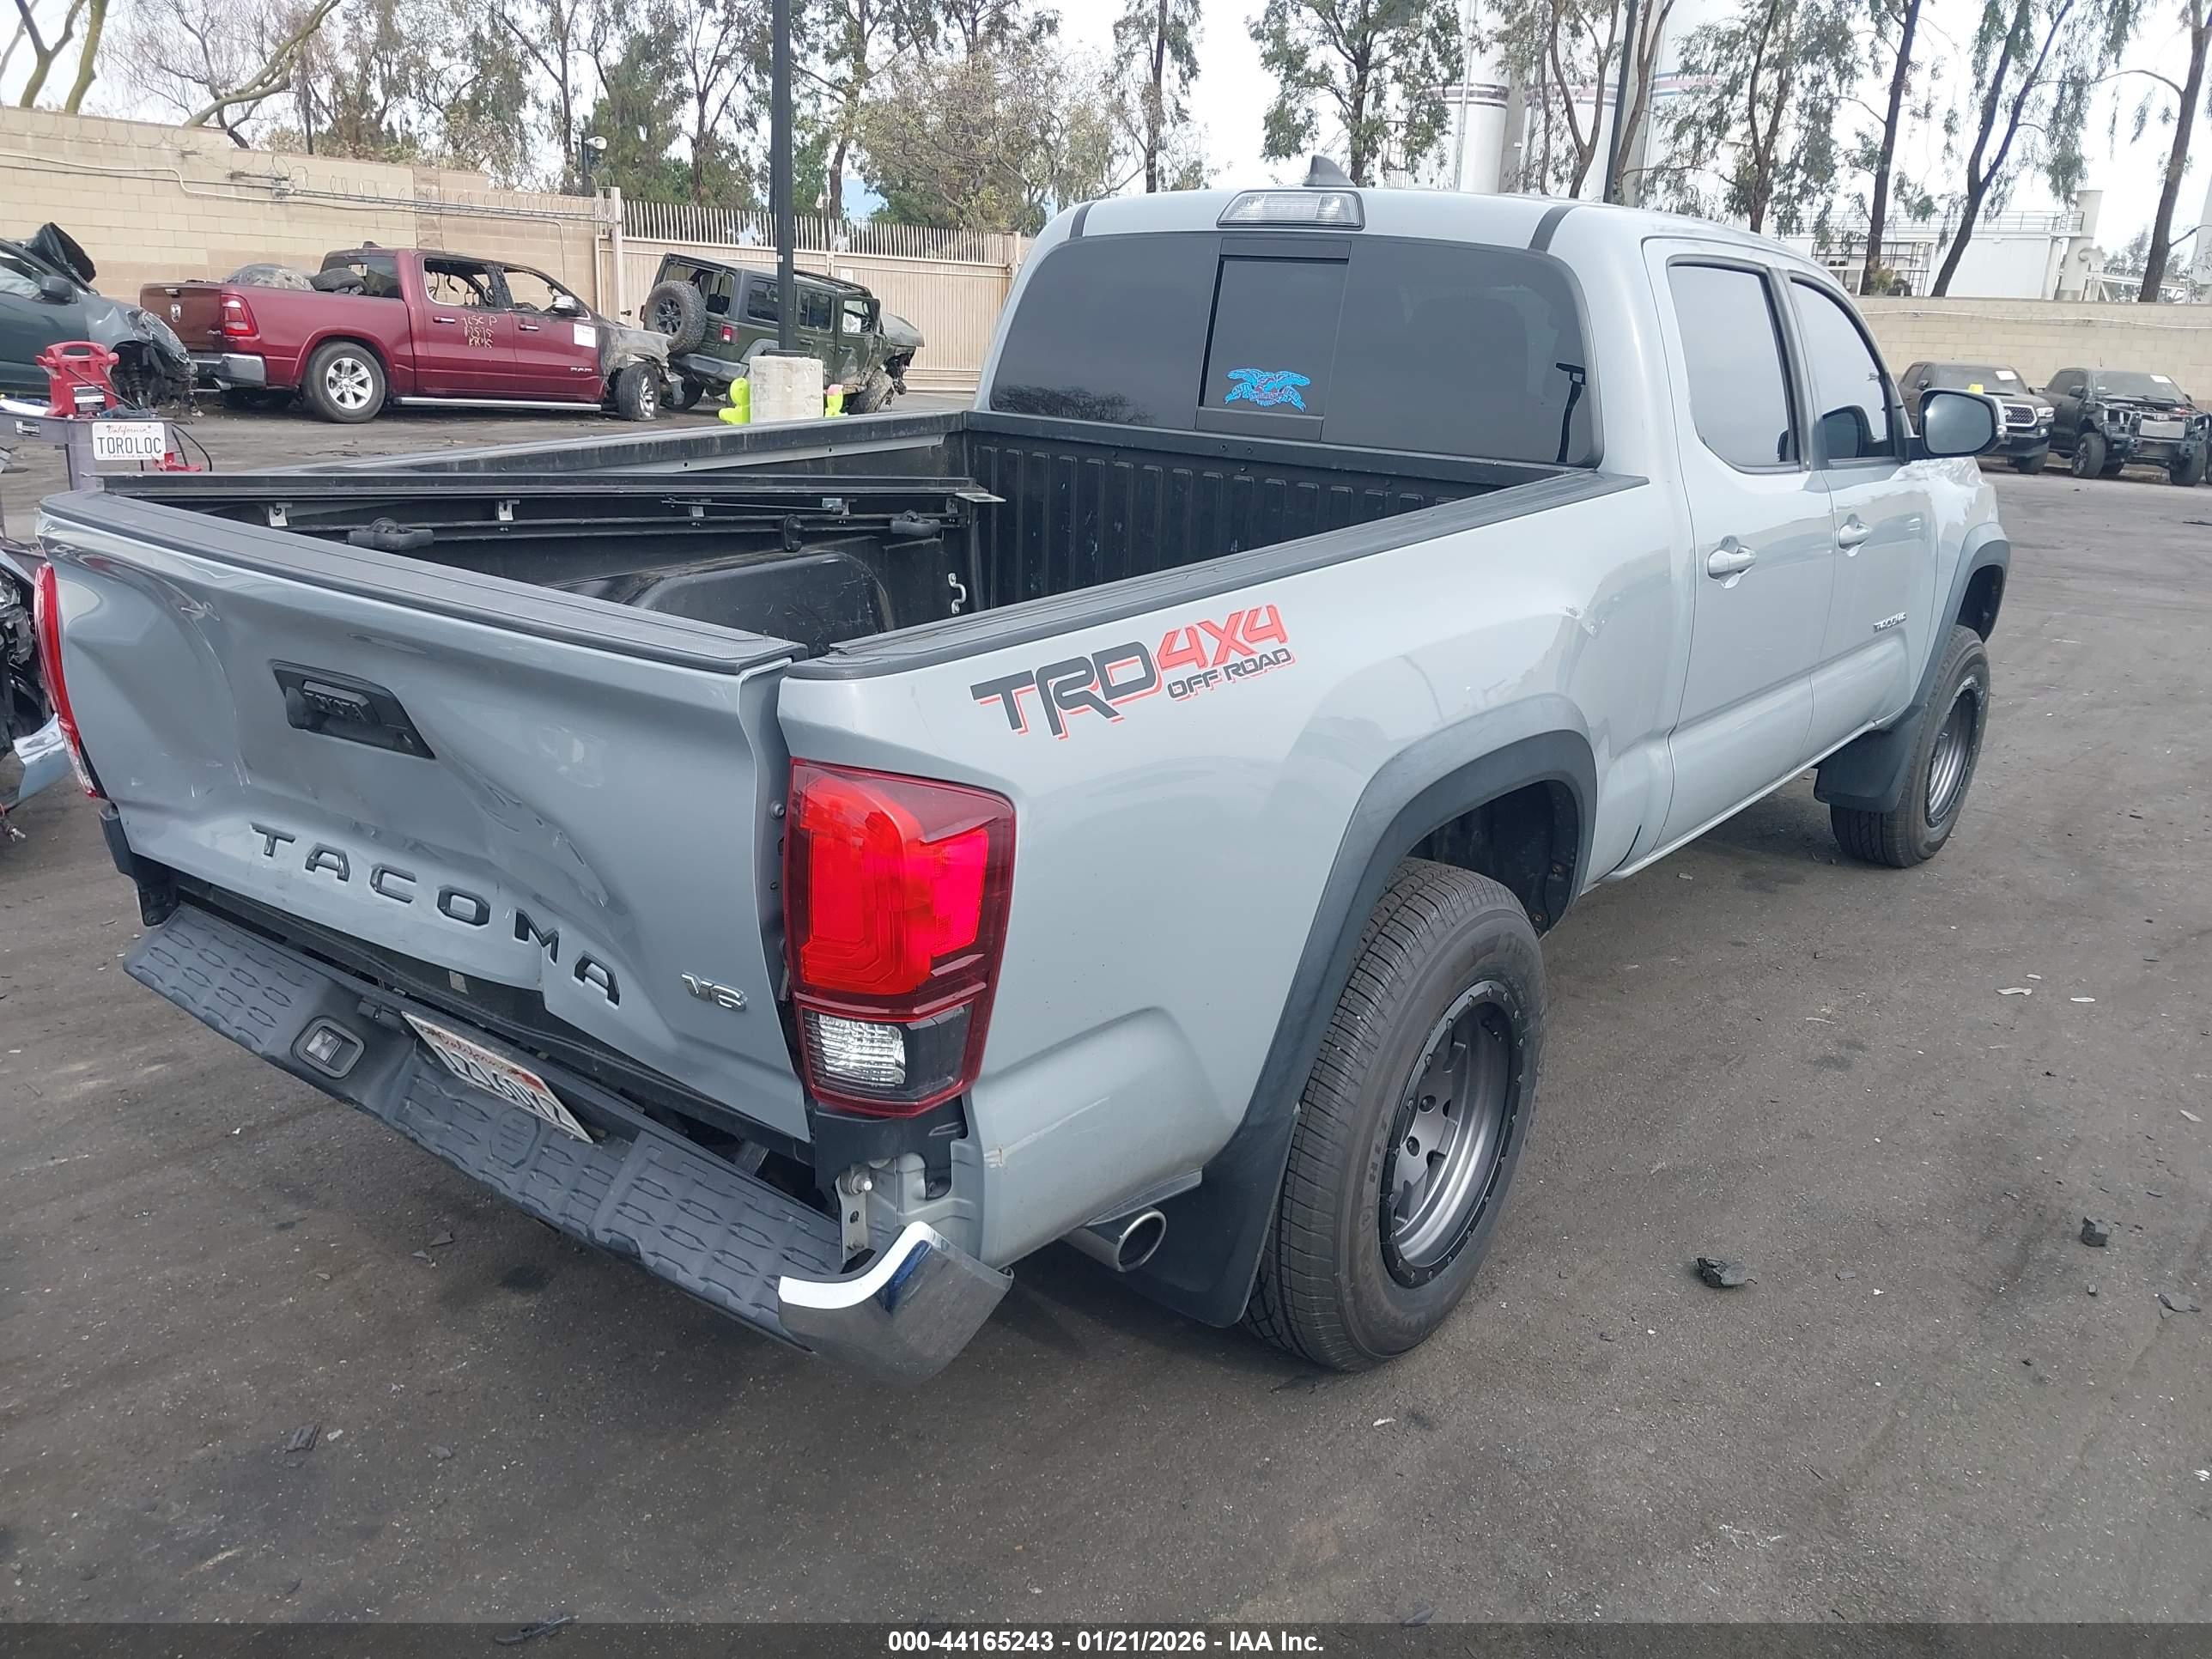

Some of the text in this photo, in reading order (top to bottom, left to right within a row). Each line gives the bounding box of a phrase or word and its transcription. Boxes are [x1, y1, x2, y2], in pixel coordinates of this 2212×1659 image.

[97, 437, 161, 454] TOROLOC
[106, 424, 148, 435] California
[969, 604, 1289, 740] TRD 4X4
[1166, 647, 1296, 702] OFF ROAD
[249, 822, 621, 1009] TACOMA
[681, 971, 748, 1012] V6
